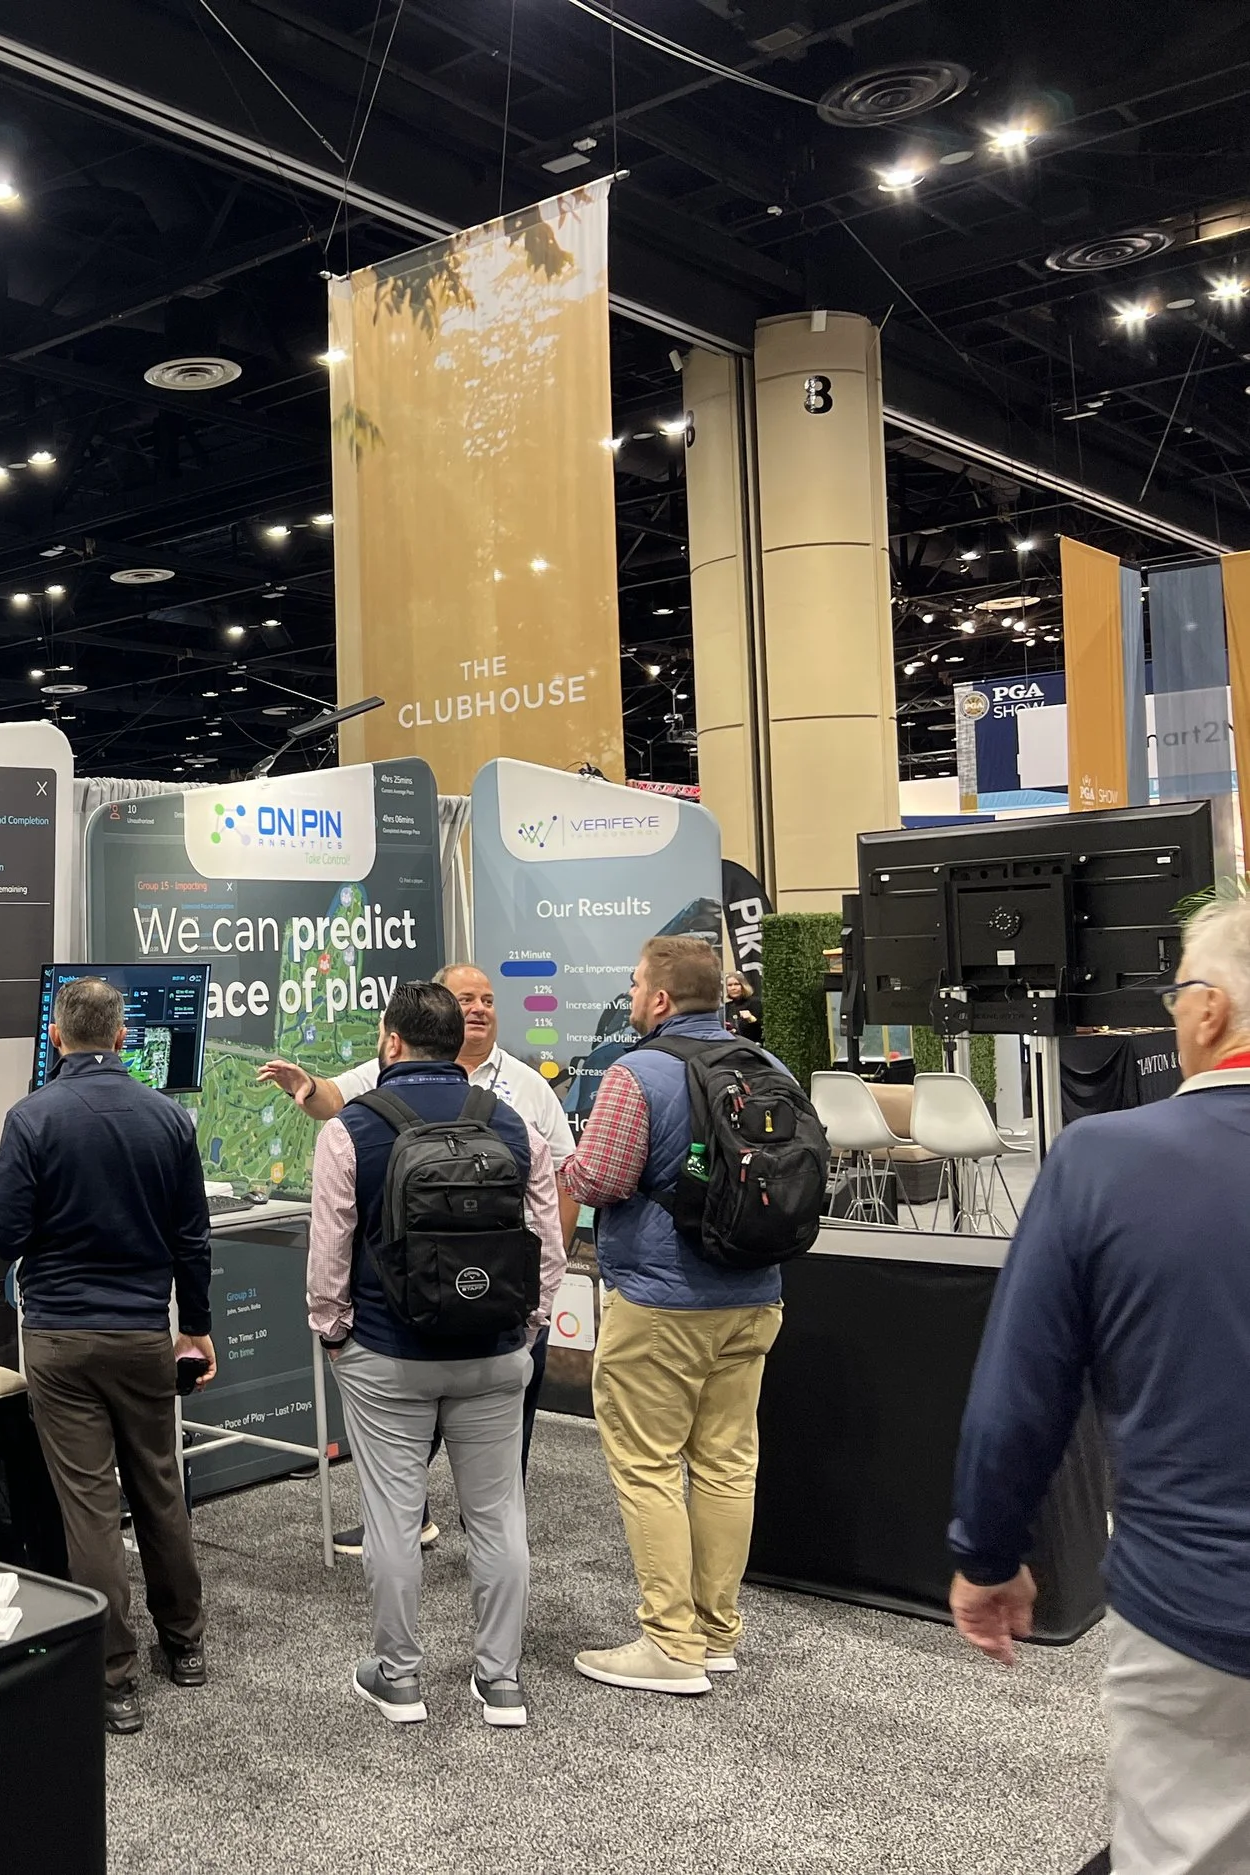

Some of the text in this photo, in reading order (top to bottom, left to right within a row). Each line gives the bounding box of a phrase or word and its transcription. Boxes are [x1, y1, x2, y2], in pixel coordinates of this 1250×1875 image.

[804, 375, 833, 415] 8
[460, 656, 507, 681] THE
[992, 682, 1045, 702] PGA
[398, 675, 587, 729] CLUBHOUSE
[127, 804, 137, 814] 10
[8, 816, 49, 826] Completion
[570, 815, 659, 831] VERIFEYE
[258, 839, 343, 850] ANALYTICS
[305, 852, 321, 865] Take
[138, 881, 208, 892] Group 15 Impacting
[537, 897, 651, 918] Our Results
[133, 904, 417, 962] We can predict
[509, 950, 551, 959] 21 Minute
[564, 964, 585, 974] Pace
[206, 980, 270, 1018] ace
[279, 966, 318, 1014] of
[534, 985, 552, 994] 12%
[566, 1001, 602, 1010] Increase
[603, 1000, 611, 1009] in
[534, 1018, 553, 1027] 11%
[566, 1033, 602, 1042] Increase
[603, 1033, 611, 1042] in
[540, 1051, 553, 1060] 3%
[226, 1288, 257, 1301] Group 31
[228, 1336, 238, 1345] Tee
[228, 1347, 254, 1360] On time
[225, 1400, 312, 1429] Pace of Play Last 7 Days
